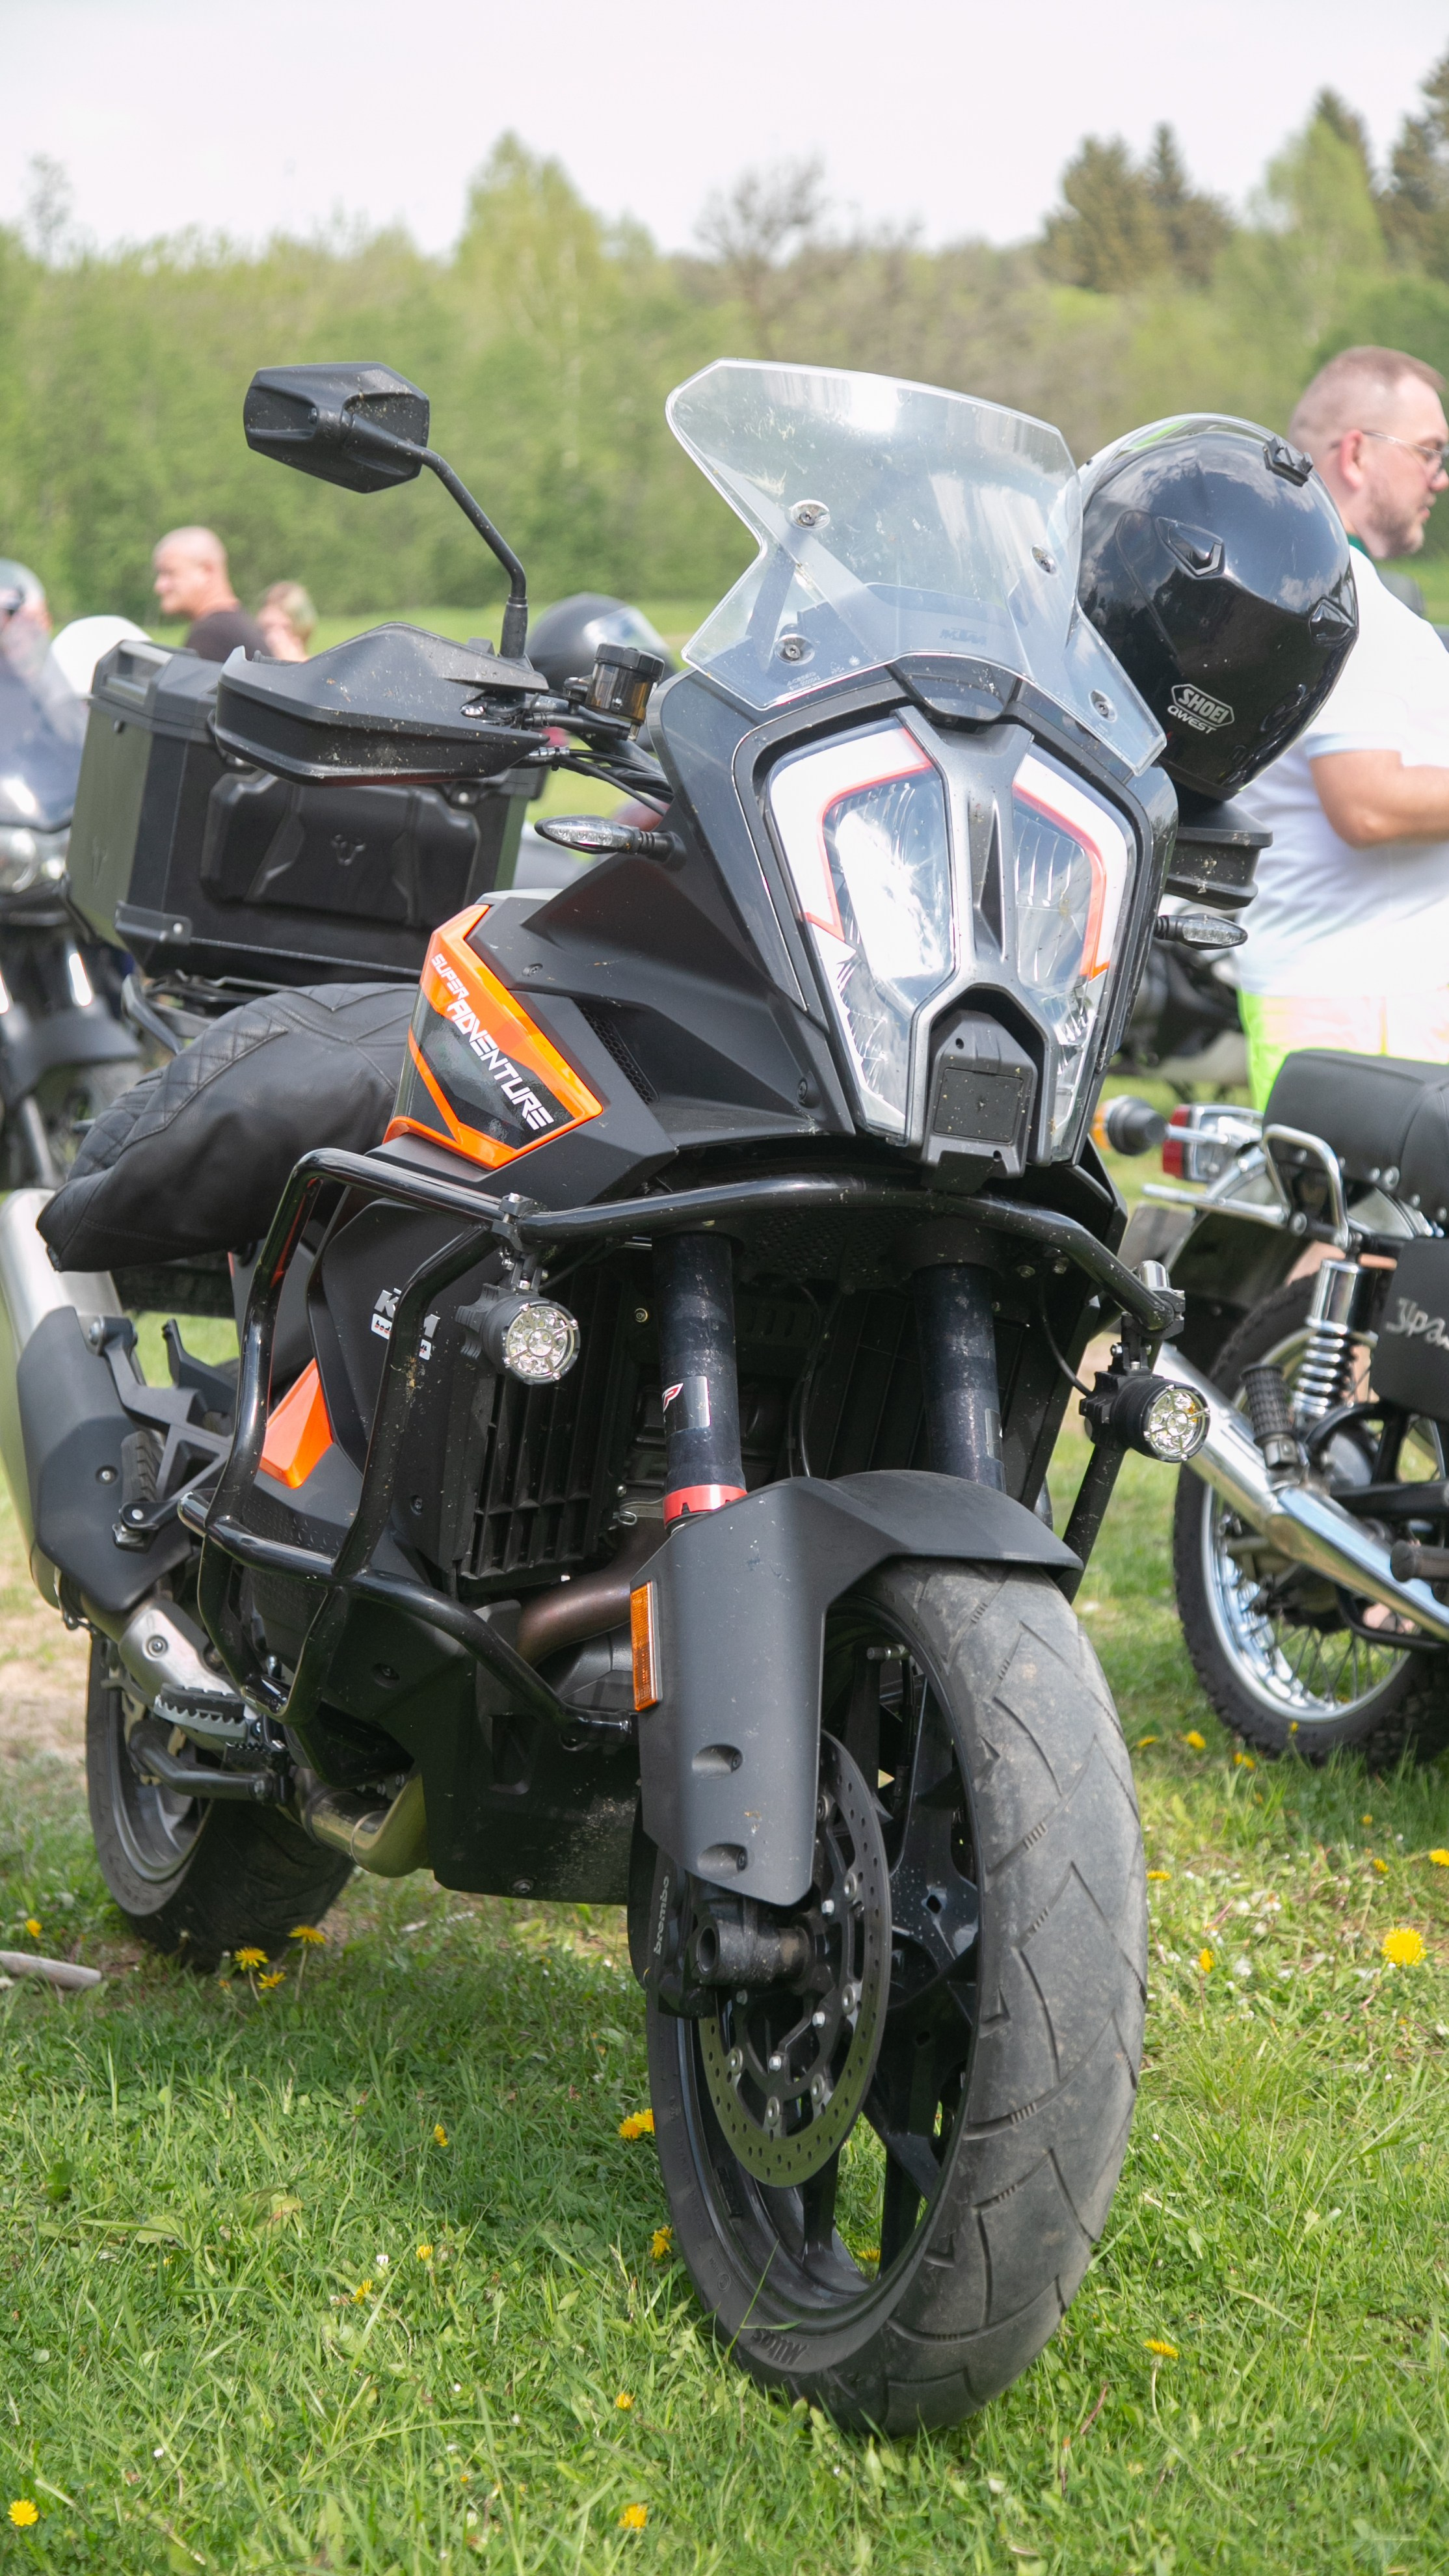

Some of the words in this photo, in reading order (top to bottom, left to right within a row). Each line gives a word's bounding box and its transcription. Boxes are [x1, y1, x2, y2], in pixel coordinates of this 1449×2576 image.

[938, 627, 987, 646] KTM
[1167, 705, 1217, 734] QWEST
[1178, 688, 1229, 723] SHOEI
[431, 953, 470, 1000] SUPER
[447, 999, 554, 1131] ADVENTURE
[654, 1876, 669, 1955] brembo
